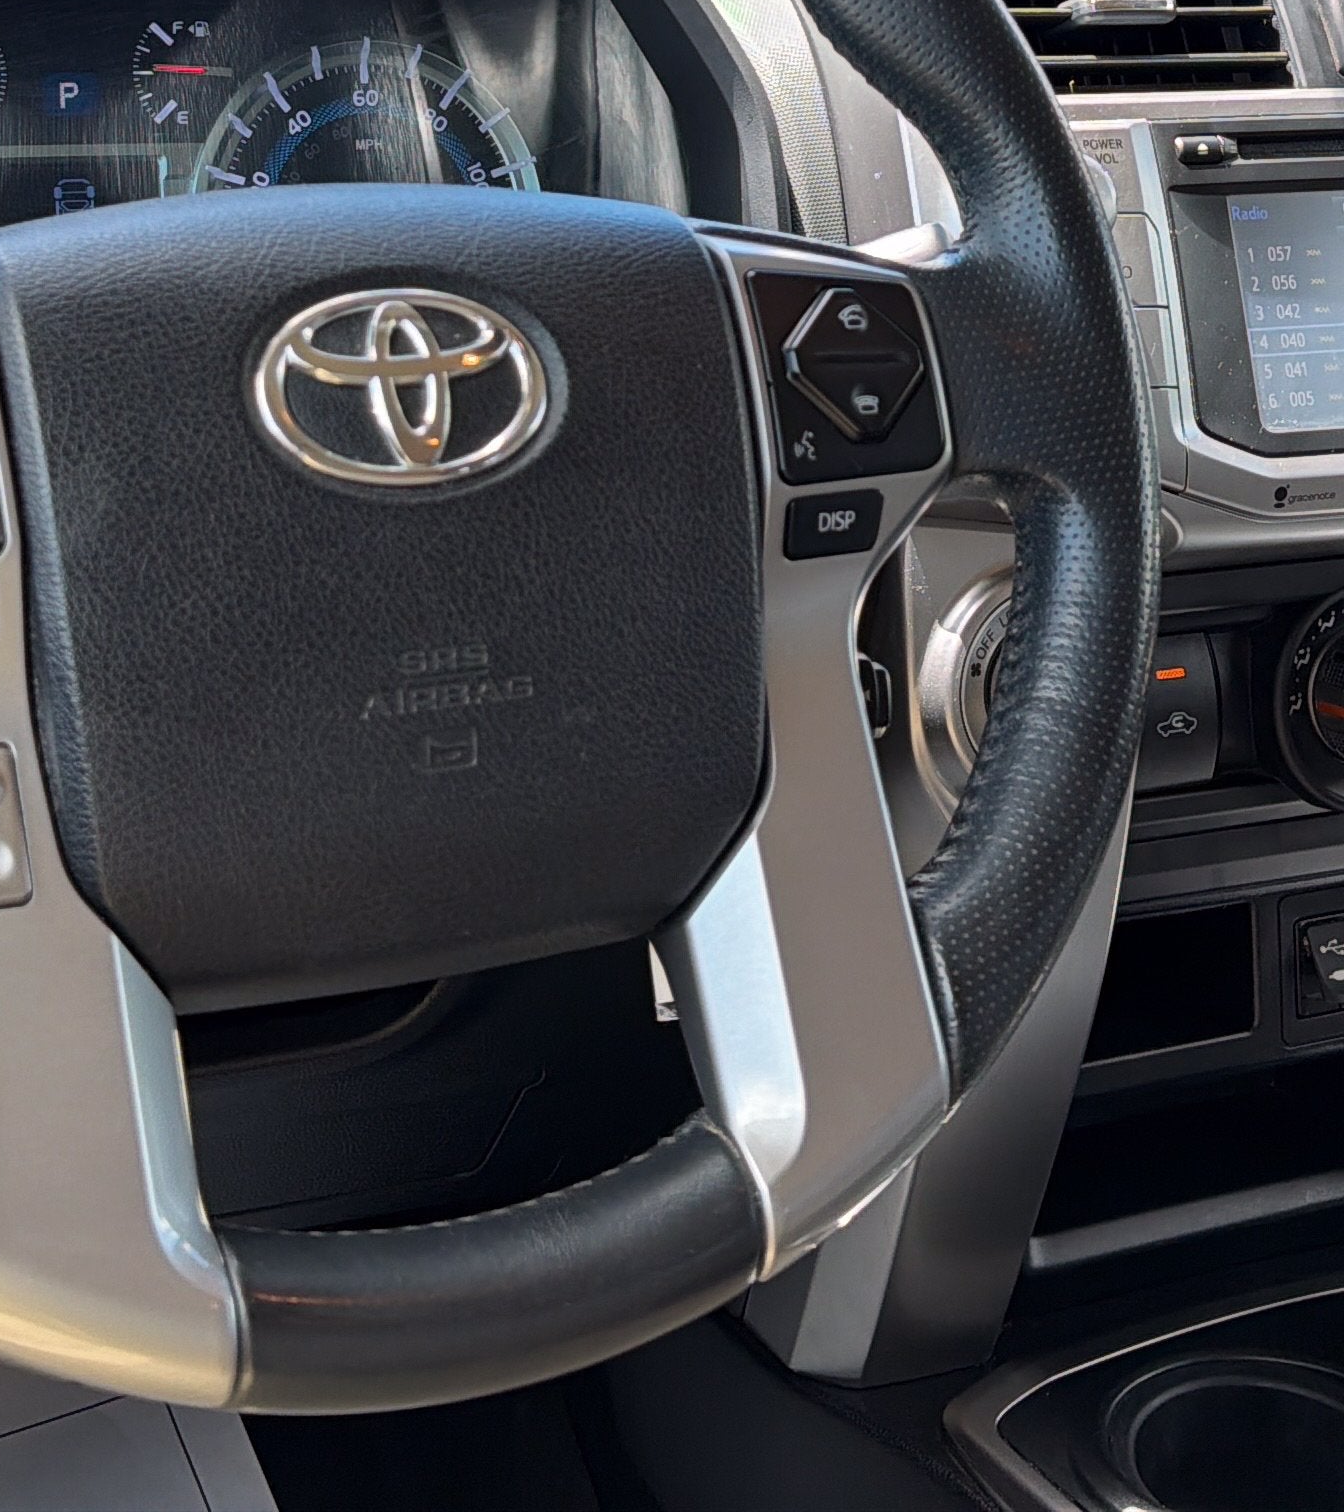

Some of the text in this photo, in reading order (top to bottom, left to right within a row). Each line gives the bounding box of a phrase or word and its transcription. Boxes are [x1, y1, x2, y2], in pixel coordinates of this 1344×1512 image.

[172, 21, 184, 34] F
[59, 82, 79, 109] P
[352, 89, 379, 107] 60
[177, 111, 189, 125] E
[287, 110, 312, 136] 40
[424, 107, 448, 132] 80
[355, 139, 382, 151] MPH
[1083, 139, 1123, 150] POWER
[1095, 153, 1119, 164] VOL
[1231, 206, 1269, 221] Radio
[1247, 247, 1255, 263] 1
[1267, 245, 1292, 262] 057
[1251, 276, 1260, 292] 2
[1271, 275, 1297, 290] 056
[1256, 305, 1264, 321] 3
[1276, 303, 1301, 319] 042
[1260, 334, 1268, 349] 4
[1280, 332, 1305, 348] 040
[1264, 364, 1272, 379] 5
[1285, 362, 1307, 378] 041
[1268, 393, 1277, 409] 6
[1289, 391, 1315, 407] 005
[818, 510, 856, 533] DISP
[976, 628, 995, 660] OFF
[360, 676, 534, 719] AIRBAG
